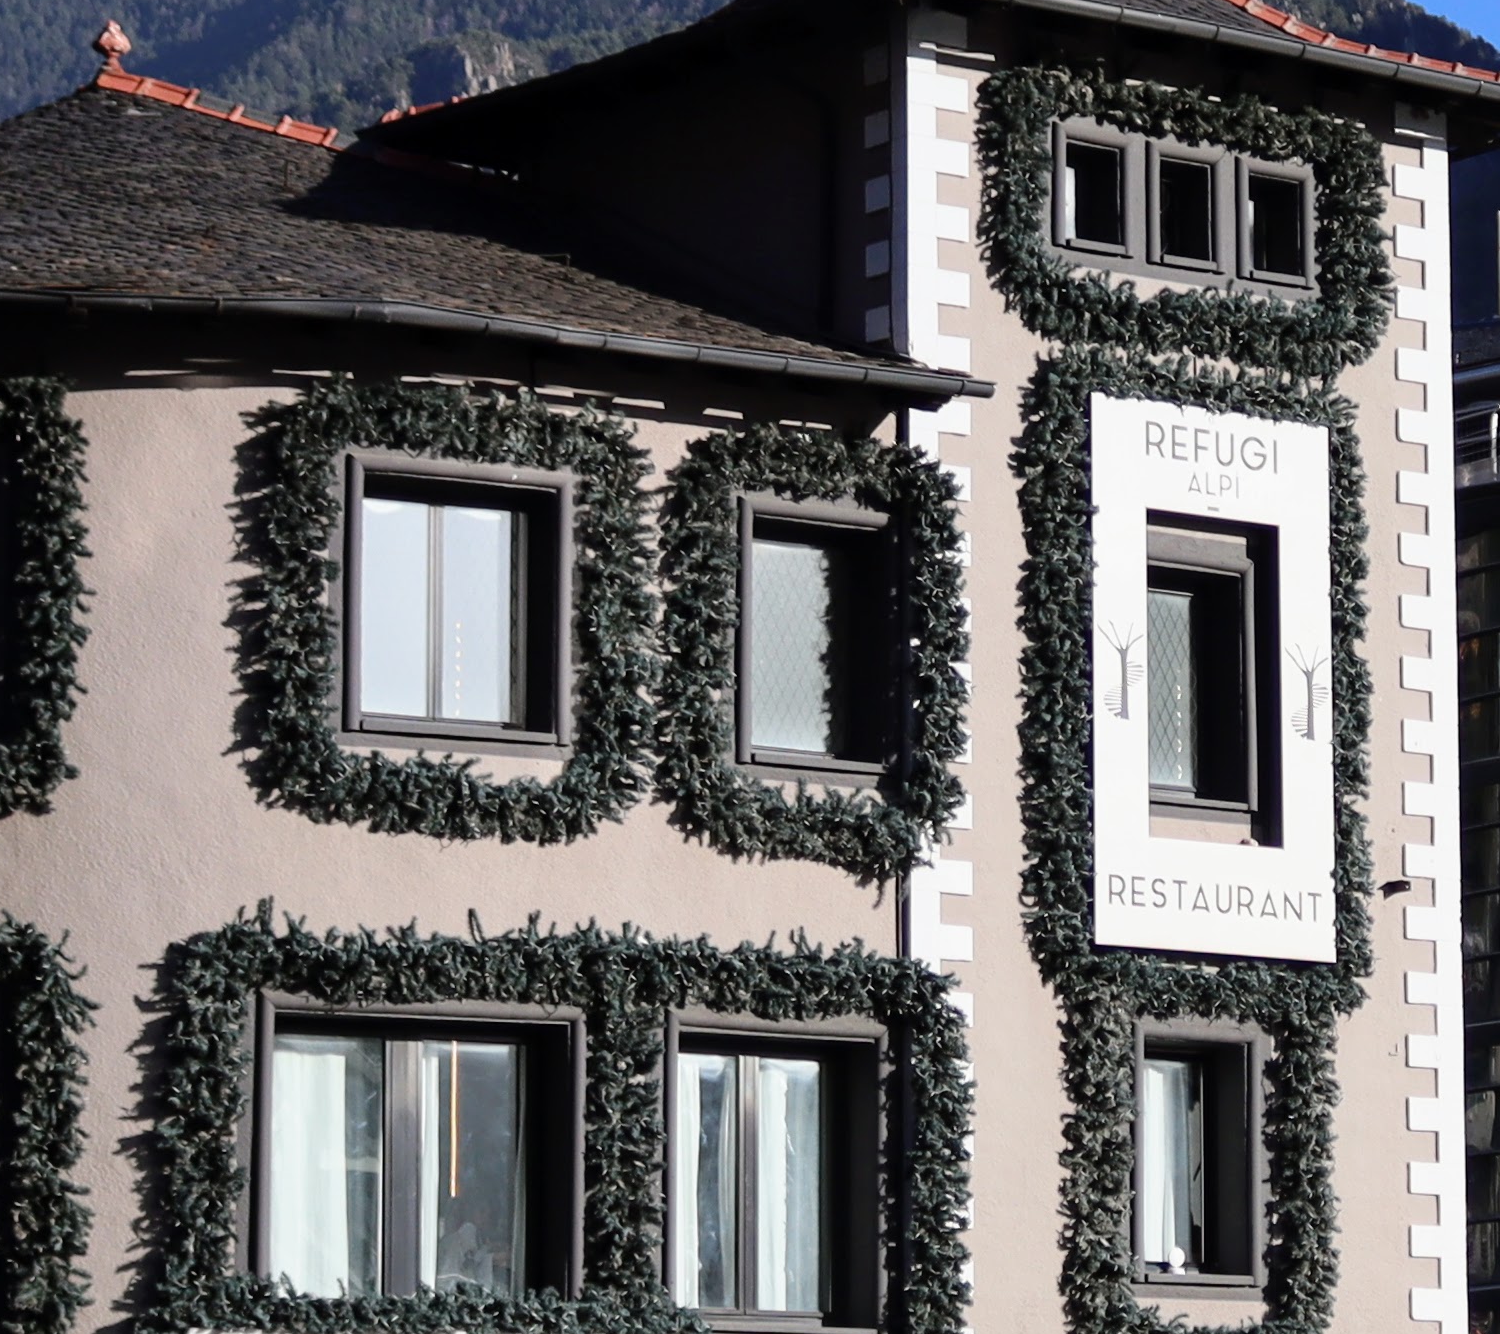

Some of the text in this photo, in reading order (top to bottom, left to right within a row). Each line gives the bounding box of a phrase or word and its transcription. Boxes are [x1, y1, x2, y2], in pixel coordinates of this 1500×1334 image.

[1146, 420, 1277, 474] REFUGI
[1188, 472, 1239, 499] ALPI
[1109, 874, 1322, 922] RESTAURANT
